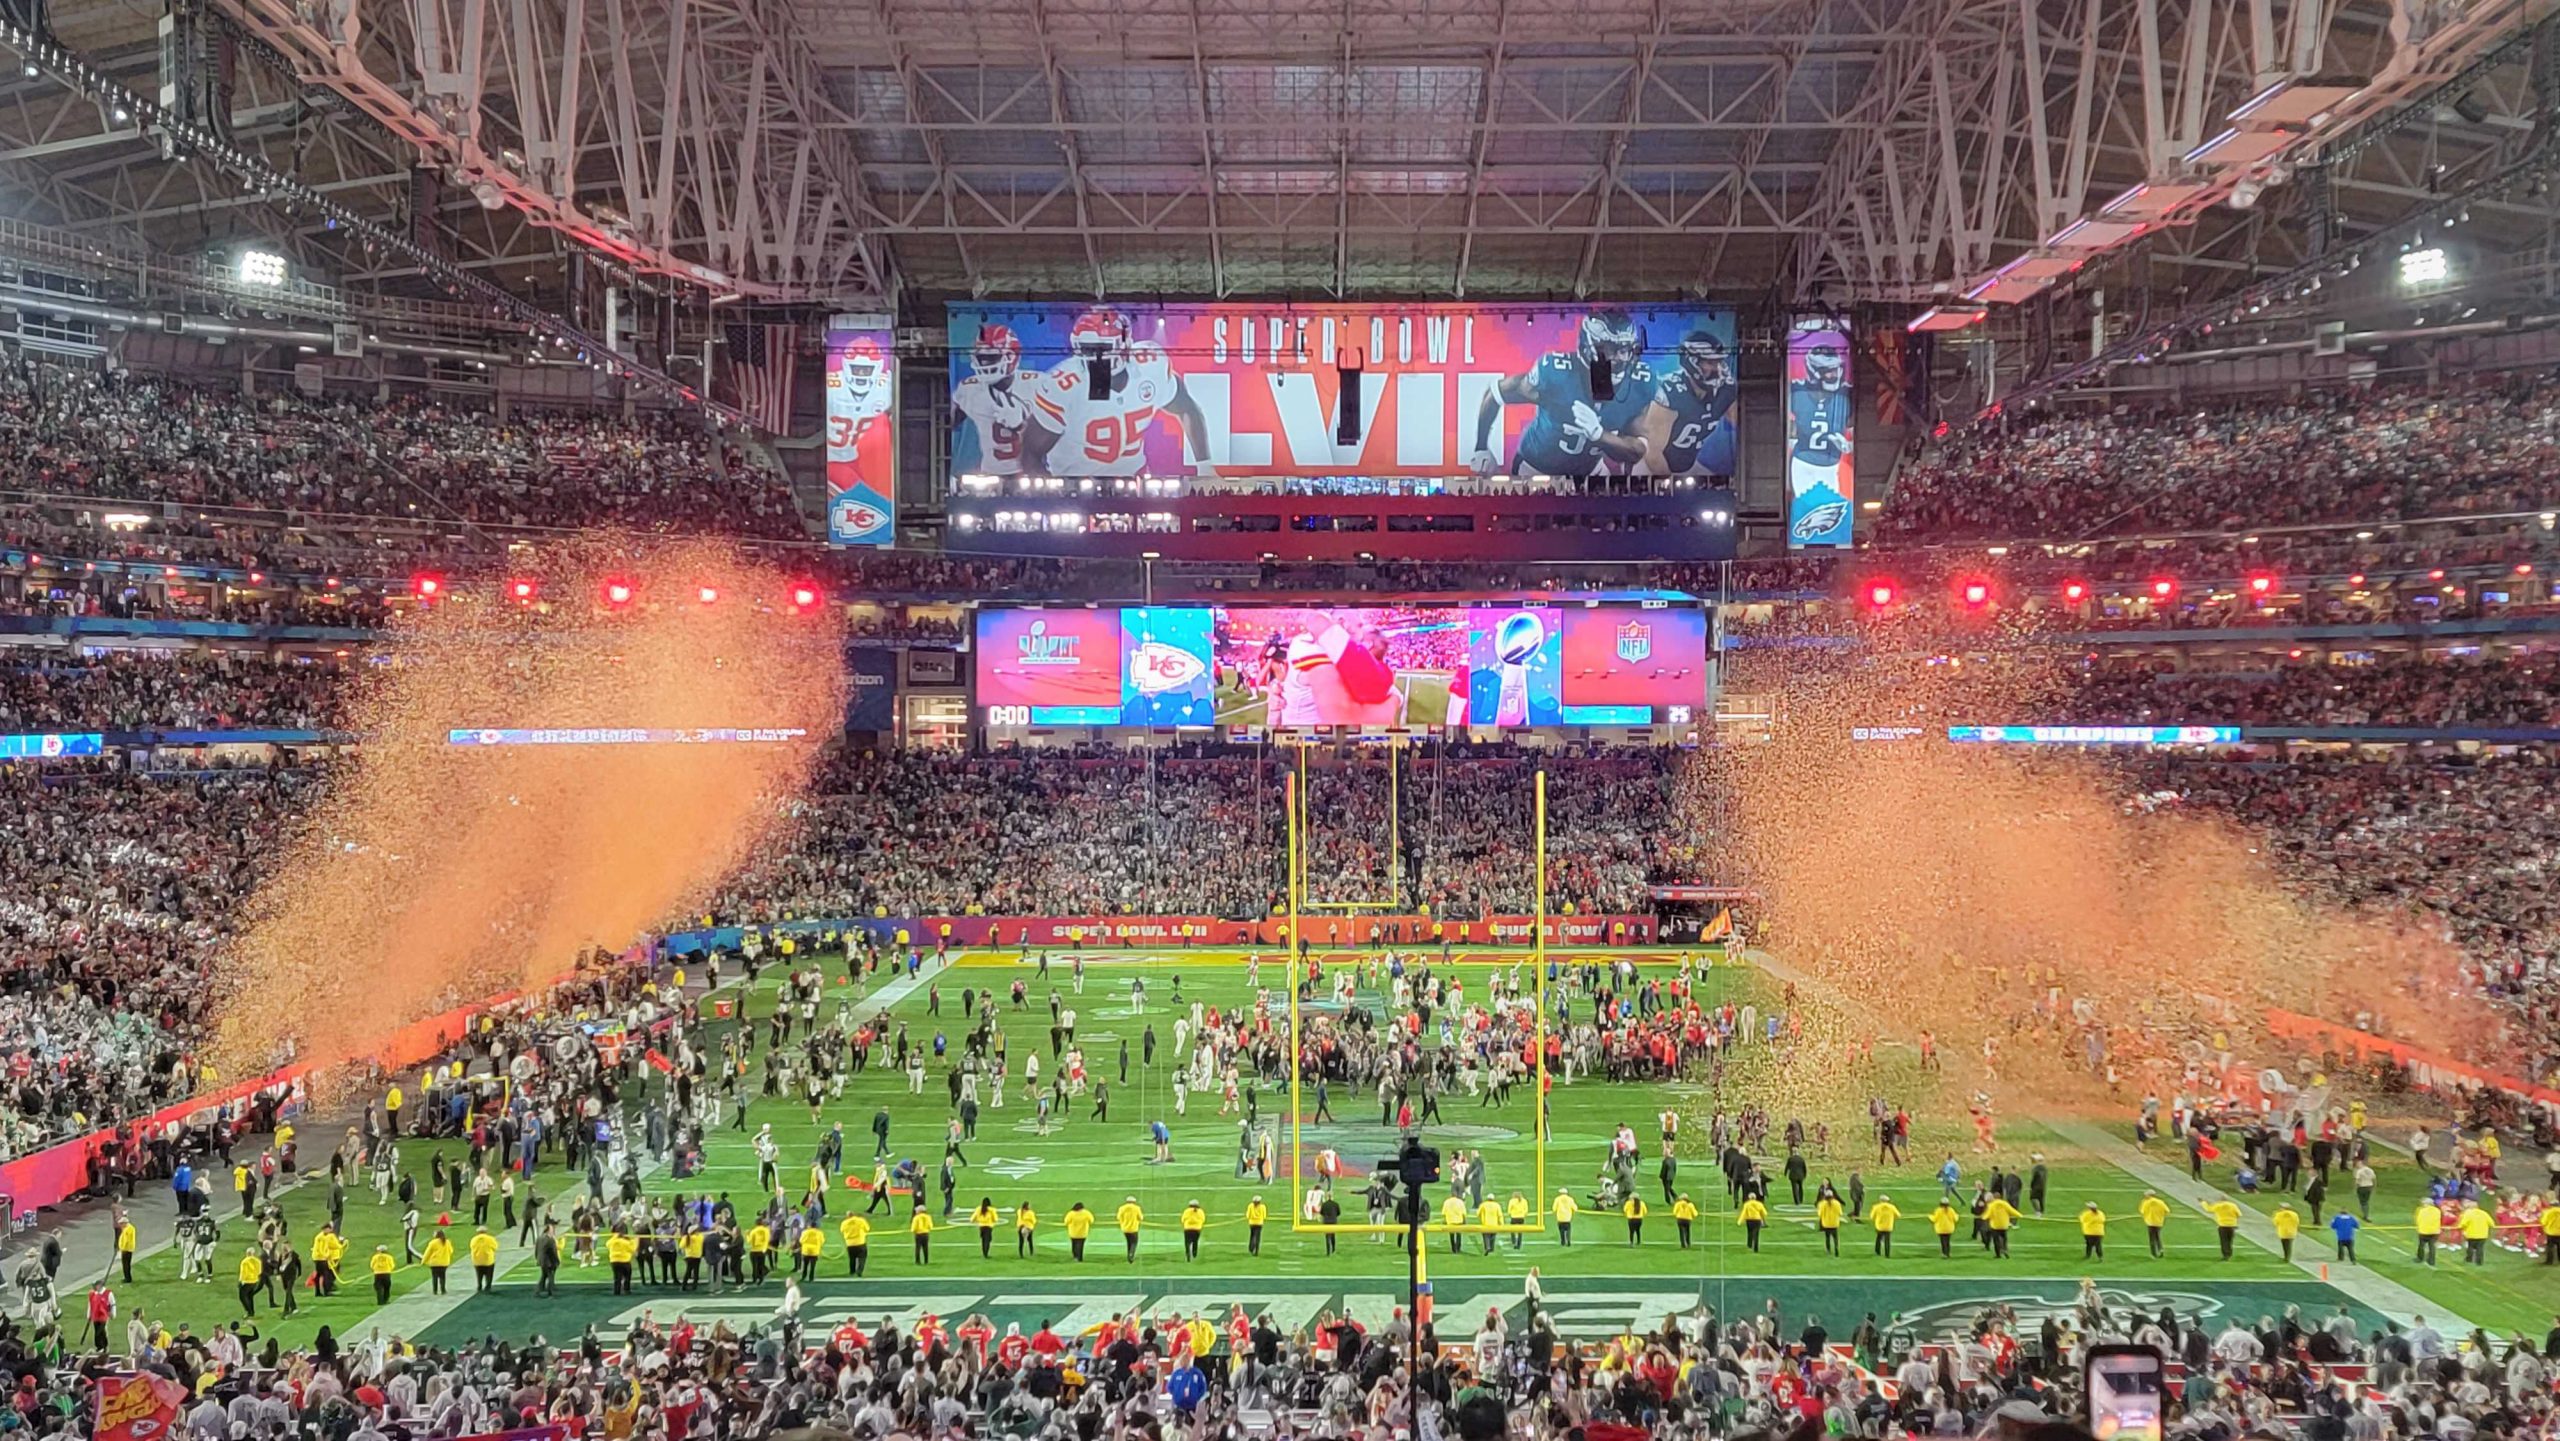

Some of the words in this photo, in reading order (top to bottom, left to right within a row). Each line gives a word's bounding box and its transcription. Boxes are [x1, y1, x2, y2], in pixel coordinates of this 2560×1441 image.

[1214, 317, 1335, 364] SUPER
[1370, 317, 1475, 364] BOWL
[1183, 373, 1505, 466] LVII
[1084, 405, 1154, 464] 95
[1809, 421, 1828, 450] 2
[845, 509, 875, 529] KC
[1622, 640, 1647, 655] NFL
[1149, 655, 1186, 678] KC
[990, 706, 1029, 725] 0:00
[1669, 706, 1690, 723] 25
[1496, 925, 1553, 936] SUPR
